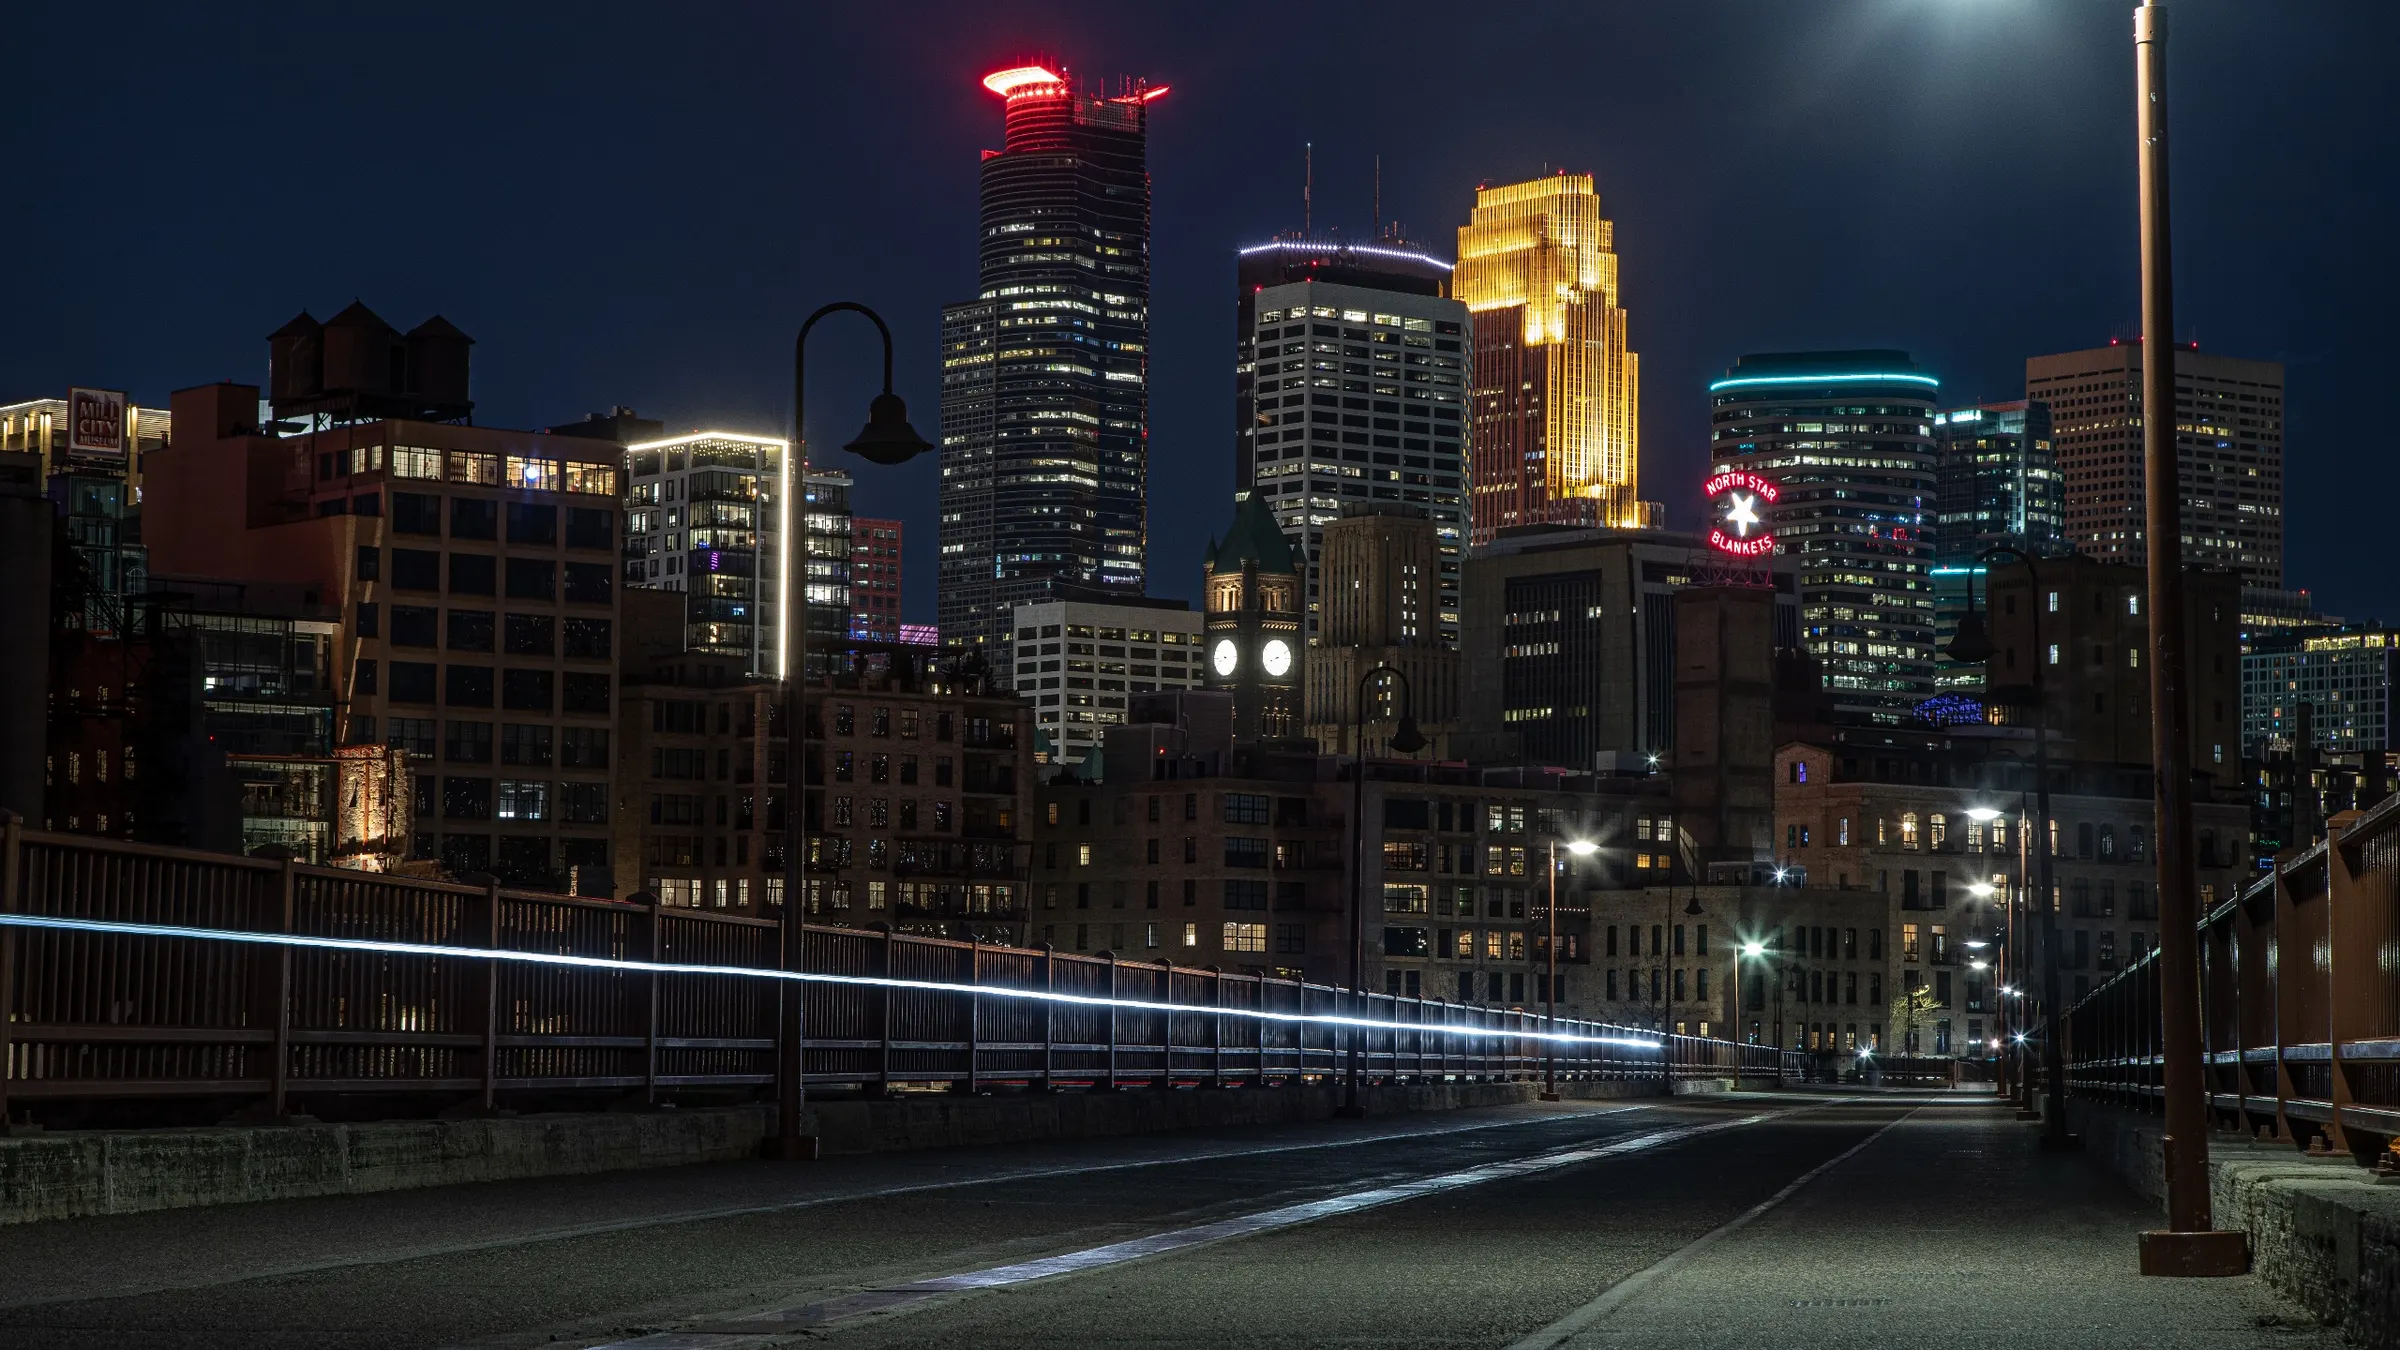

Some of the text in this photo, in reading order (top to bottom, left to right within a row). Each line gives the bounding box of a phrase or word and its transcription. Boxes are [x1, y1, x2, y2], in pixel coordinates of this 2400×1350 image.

[80, 401, 119, 420] MILL
[80, 418, 118, 438] CITY
[1706, 473, 1777, 501] NORTH STAR
[1711, 531, 1772, 555] BLANKETS
